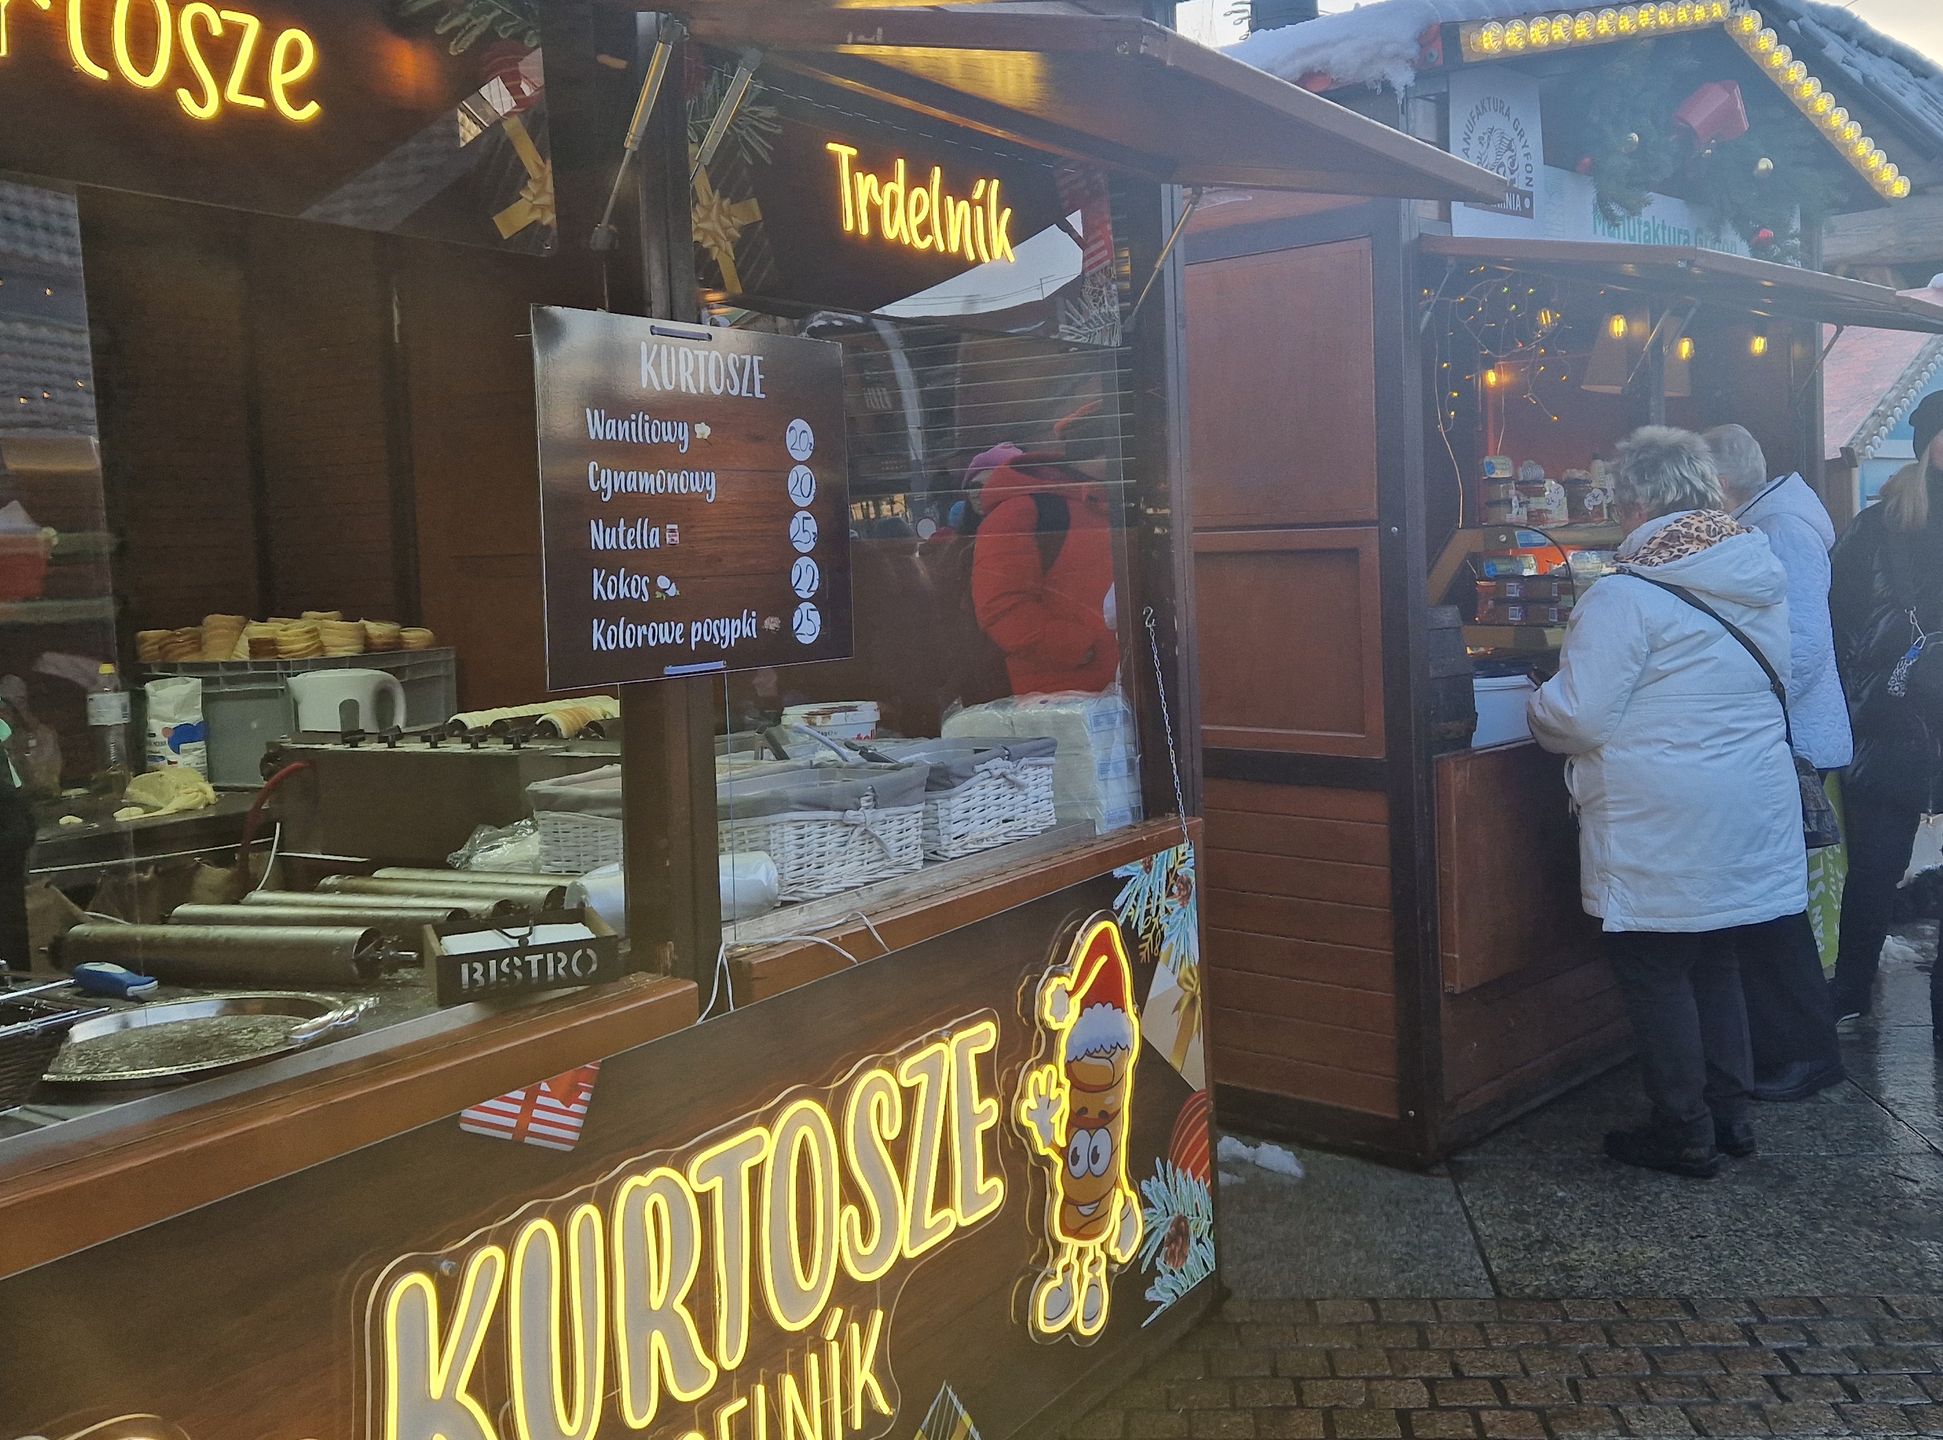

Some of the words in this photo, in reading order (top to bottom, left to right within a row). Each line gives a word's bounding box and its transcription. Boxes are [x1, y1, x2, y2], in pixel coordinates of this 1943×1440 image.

[1461, 95, 1512, 159] ANUFAKTURA
[1512, 118, 1534, 188] GRYFON
[825, 142, 1016, 264] Trdelník
[640, 341, 767, 400] KURTOSZE
[585, 407, 690, 453] Waniliowy
[588, 461, 717, 502] Cynamonowy
[589, 516, 660, 551] Nutella
[592, 567, 650, 601] Kokos
[592, 616, 684, 652] Kolorowe
[691, 610, 758, 652] posypki
[461, 948, 598, 992] BISTRO
[385, 1020, 1005, 1440] KURTOSZE
